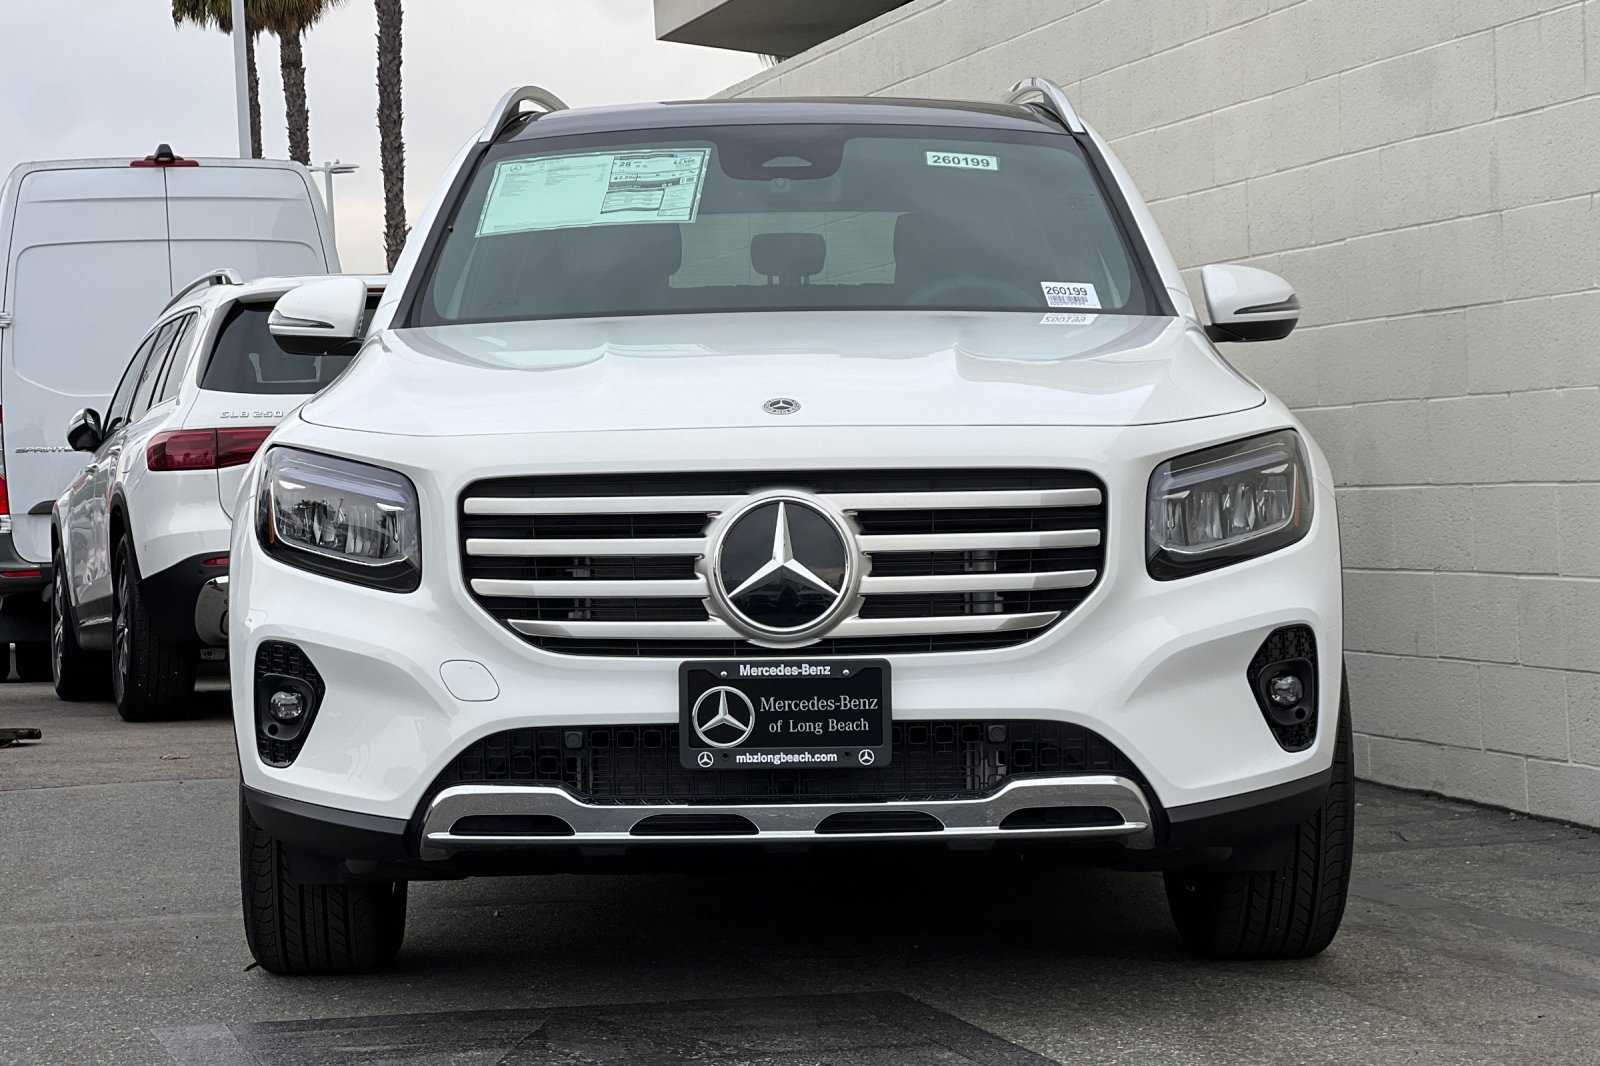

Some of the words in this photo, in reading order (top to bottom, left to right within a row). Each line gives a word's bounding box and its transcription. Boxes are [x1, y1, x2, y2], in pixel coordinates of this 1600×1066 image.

[932, 154, 990, 167] 260199
[1045, 286, 1088, 296] 260199
[220, 410, 249, 419] GLB
[253, 410, 284, 418] 250
[15, 446, 75, 454] SPRINTE
[739, 663, 831, 677] Mercedes-Benz
[759, 695, 879, 712] Mercedes-Benz
[768, 720, 783, 733] of
[789, 719, 823, 735] Long
[828, 718, 870, 732] Beach
[735, 752, 838, 765] mbzlongbeach.com
